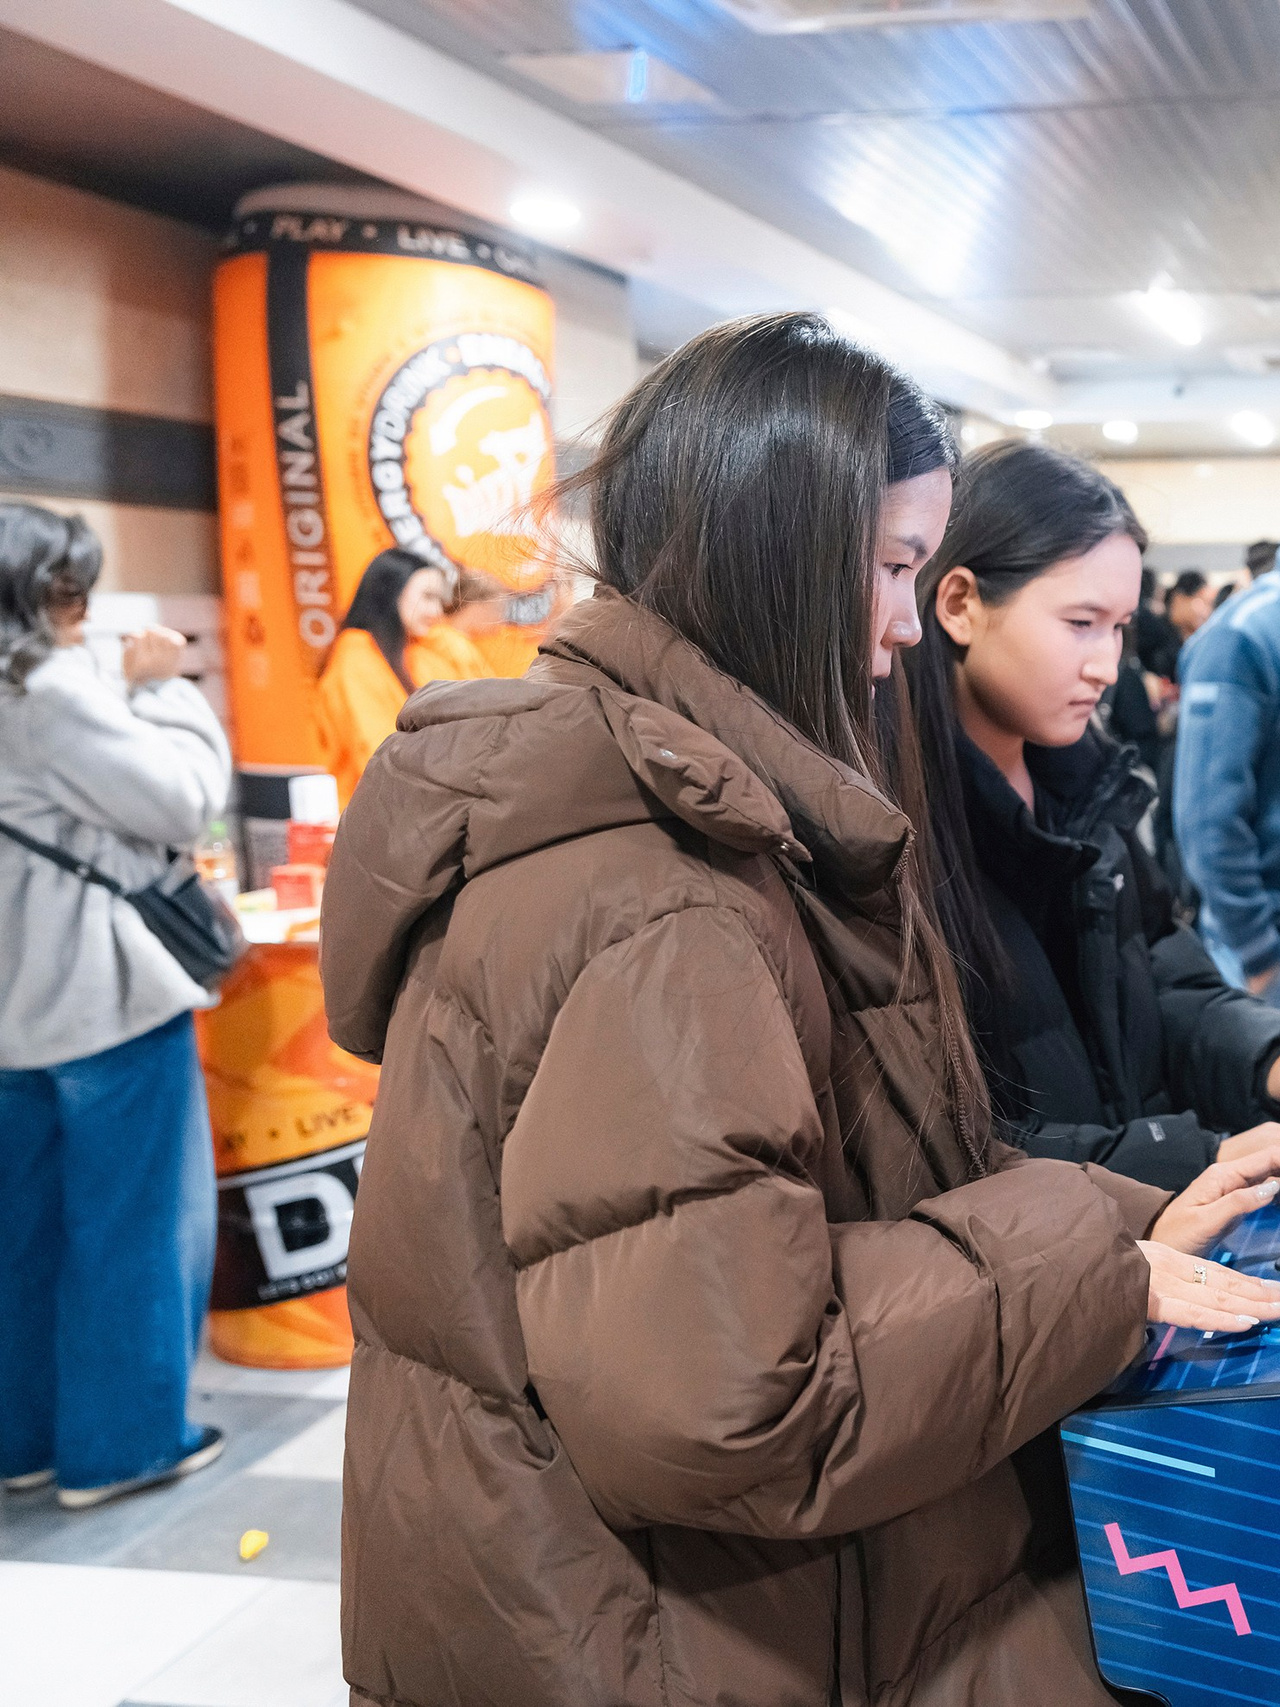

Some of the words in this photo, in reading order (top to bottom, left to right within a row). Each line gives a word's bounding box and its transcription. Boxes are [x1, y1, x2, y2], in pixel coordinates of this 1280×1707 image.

[397, 226, 471, 260] LIVE
[276, 379, 337, 649] ORIGINAL
[295, 1107, 358, 1139] LIVE
